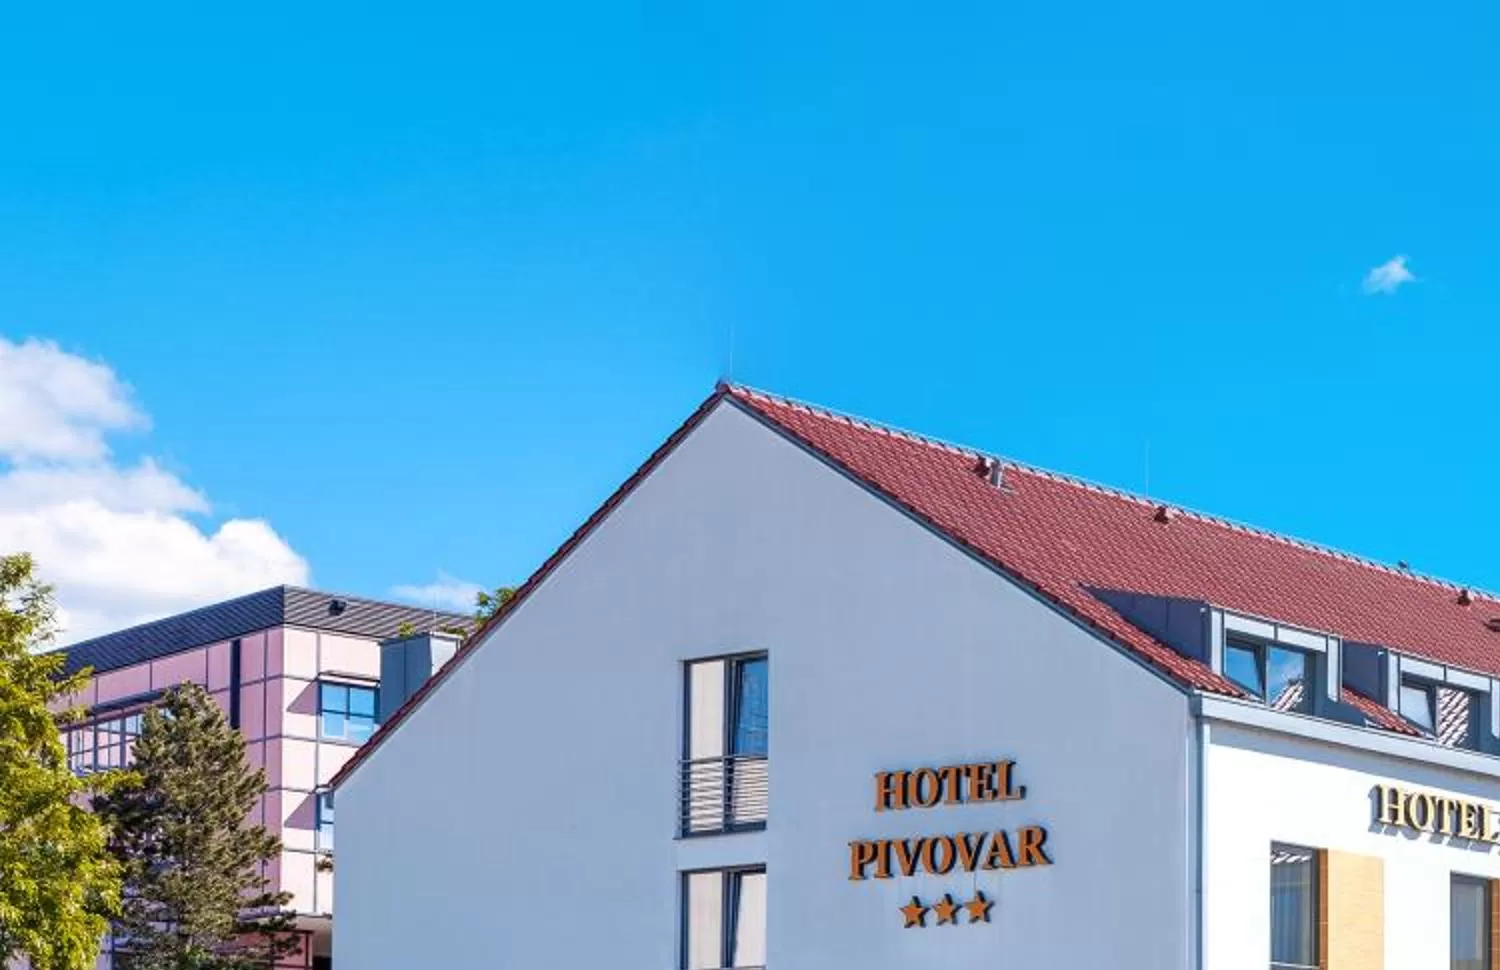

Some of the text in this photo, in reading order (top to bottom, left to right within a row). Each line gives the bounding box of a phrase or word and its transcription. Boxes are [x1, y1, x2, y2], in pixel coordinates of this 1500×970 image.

[874, 759, 1027, 812] HOTEL
[1370, 784, 1500, 846] HOTEL
[847, 825, 1054, 880] PIVOVAR
